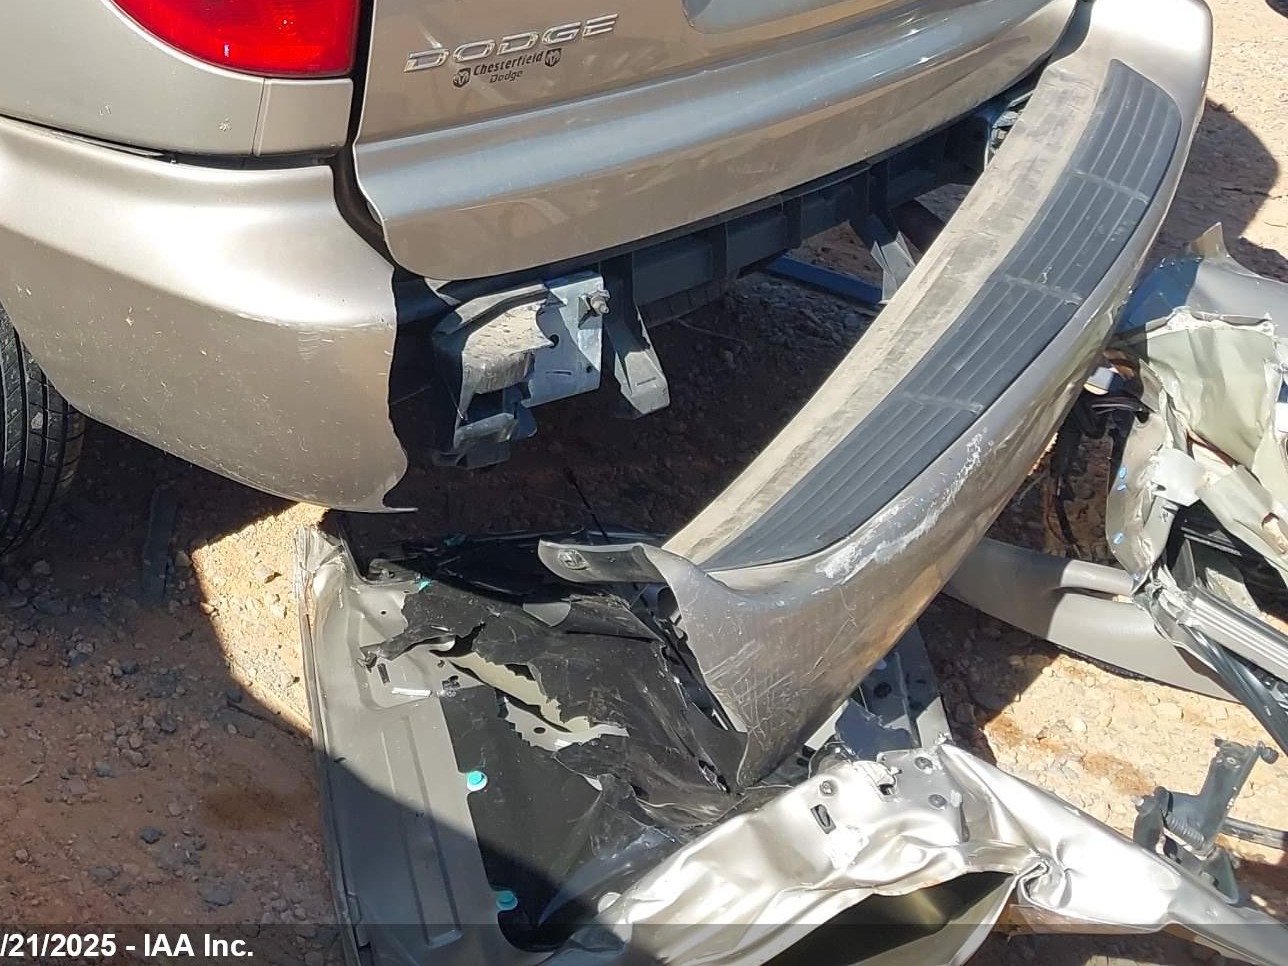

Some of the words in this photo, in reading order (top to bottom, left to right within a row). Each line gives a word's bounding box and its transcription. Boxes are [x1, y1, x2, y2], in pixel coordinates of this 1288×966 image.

[404, 13, 619, 73] DODGE
[474, 51, 543, 76] Chesterfield
[489, 70, 523, 83] Dodge
